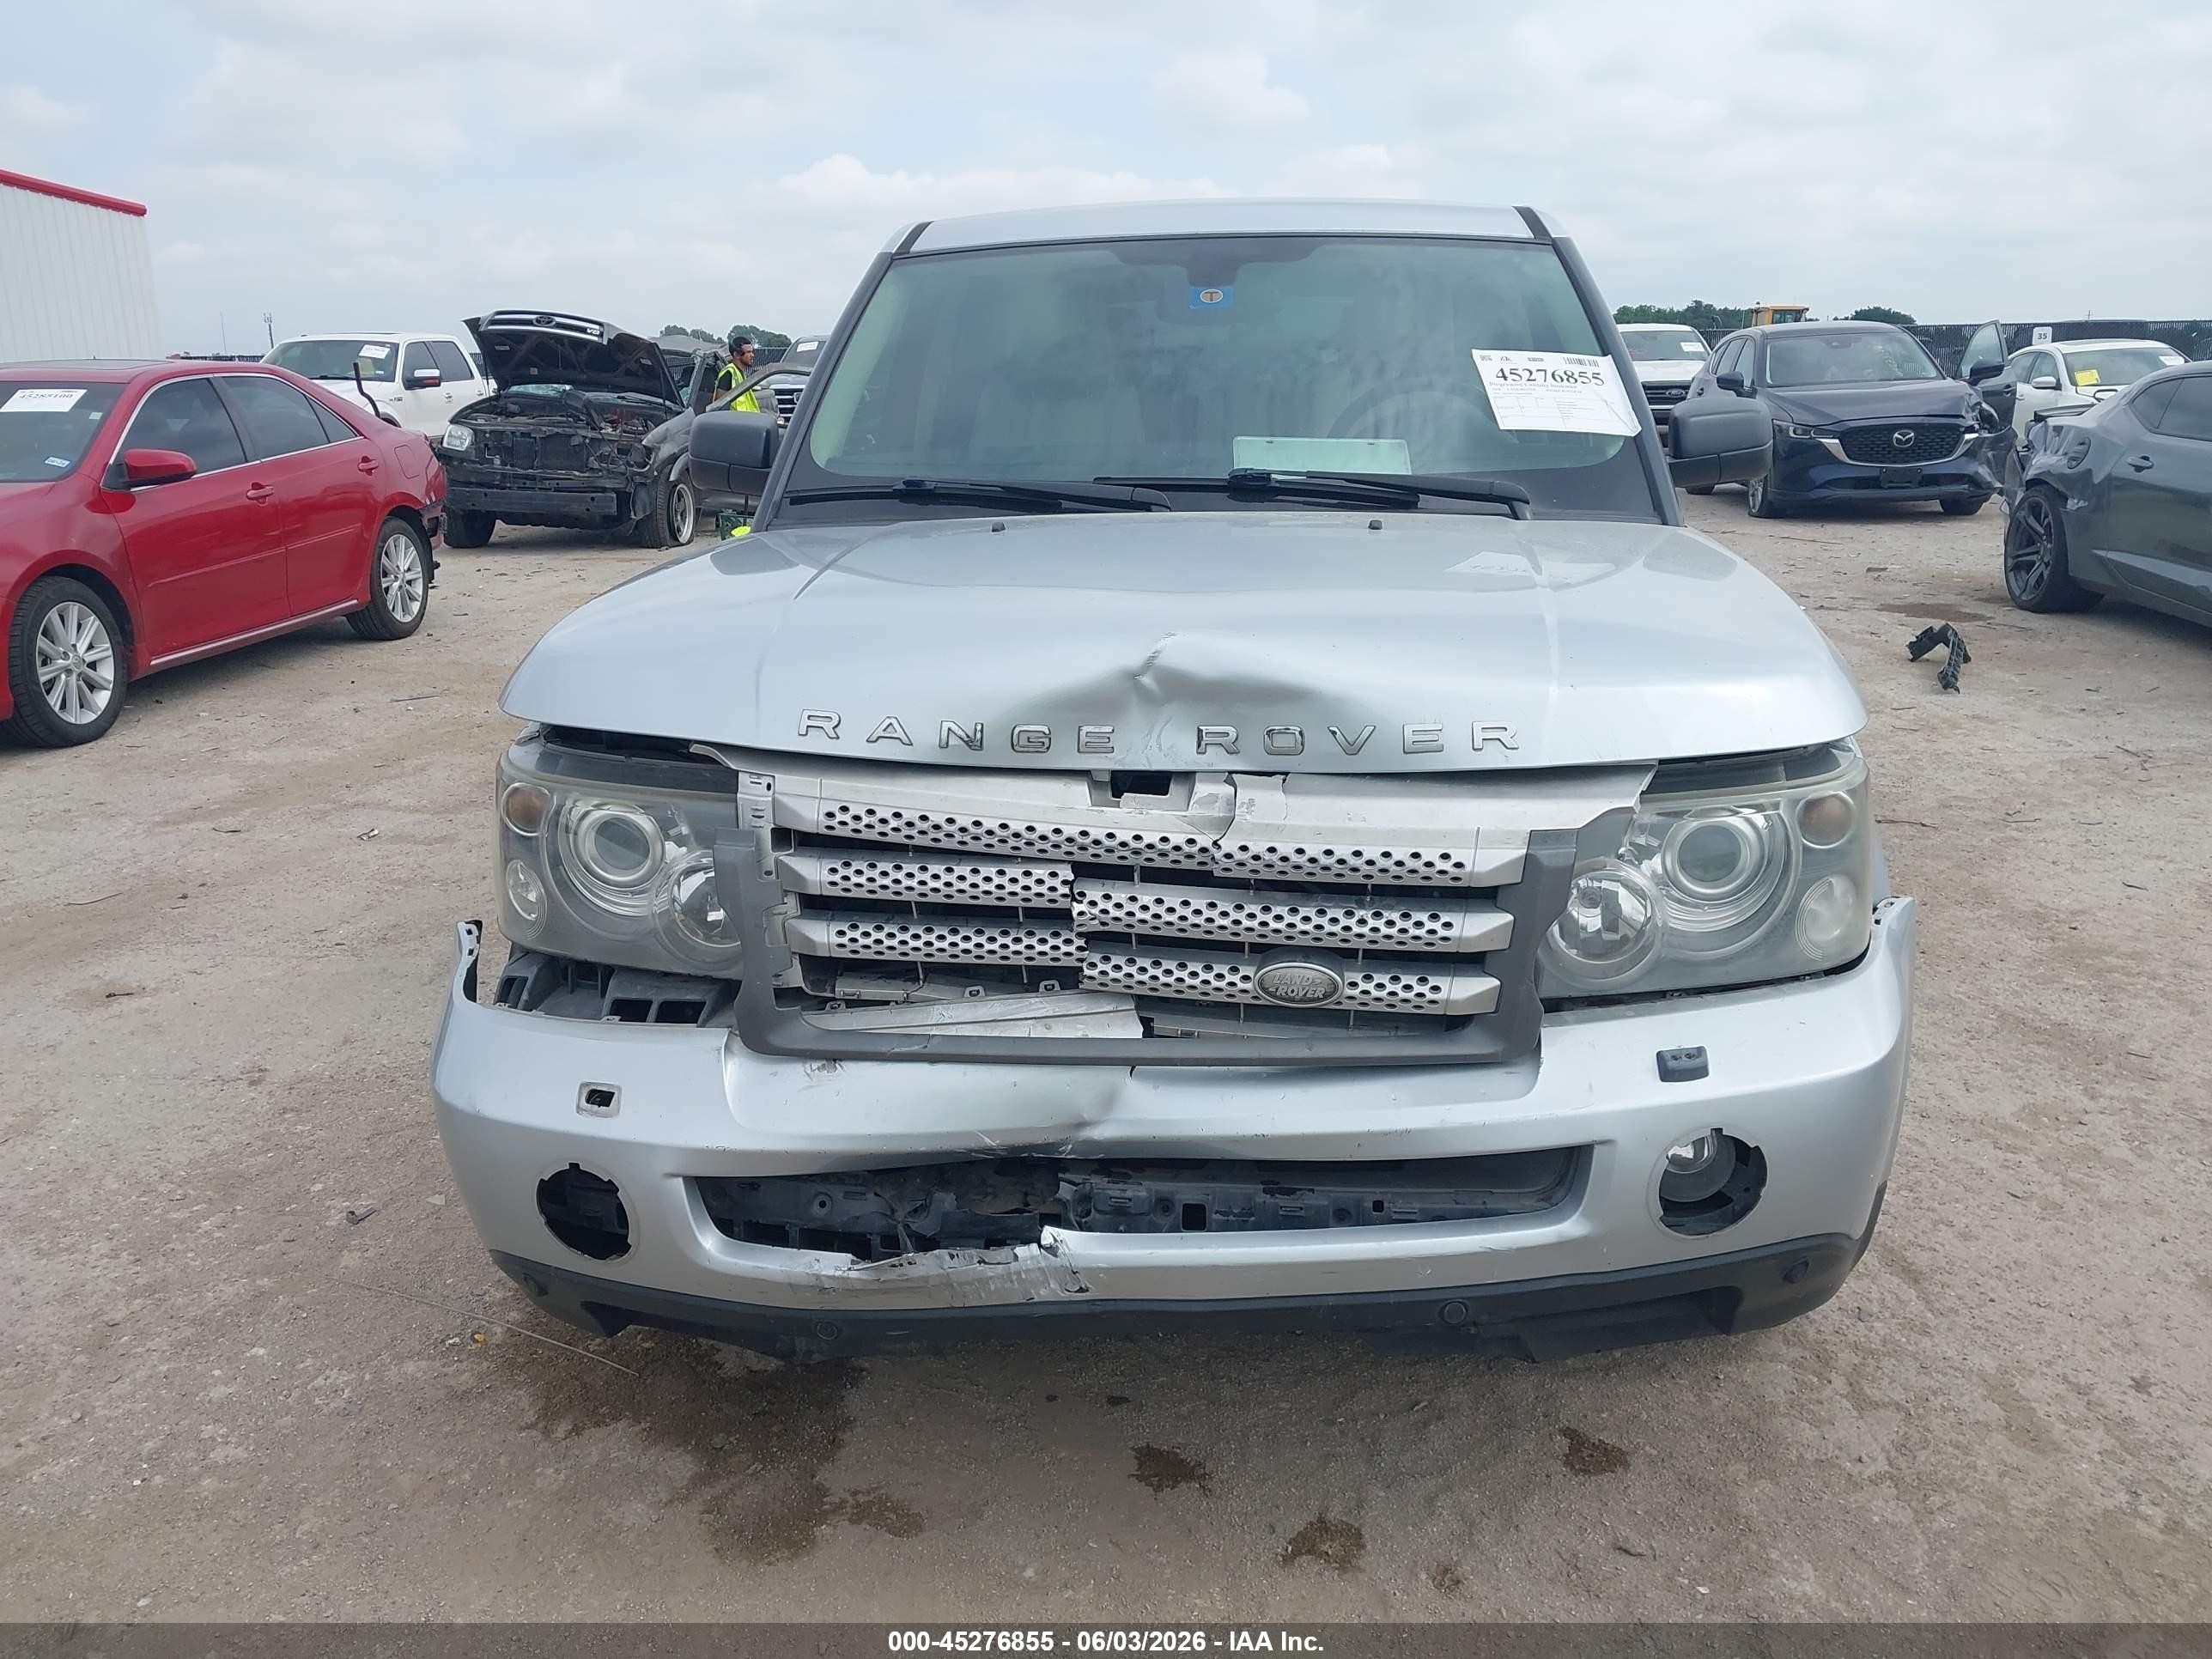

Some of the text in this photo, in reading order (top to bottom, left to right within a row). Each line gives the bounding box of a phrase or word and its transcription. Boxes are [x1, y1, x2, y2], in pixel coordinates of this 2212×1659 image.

[1495, 367, 1605, 386] 45276855
[798, 708, 1519, 756] RANGE ROVER
[1273, 972, 1313, 987] LAND
[1276, 985, 1327, 999] ROVER
